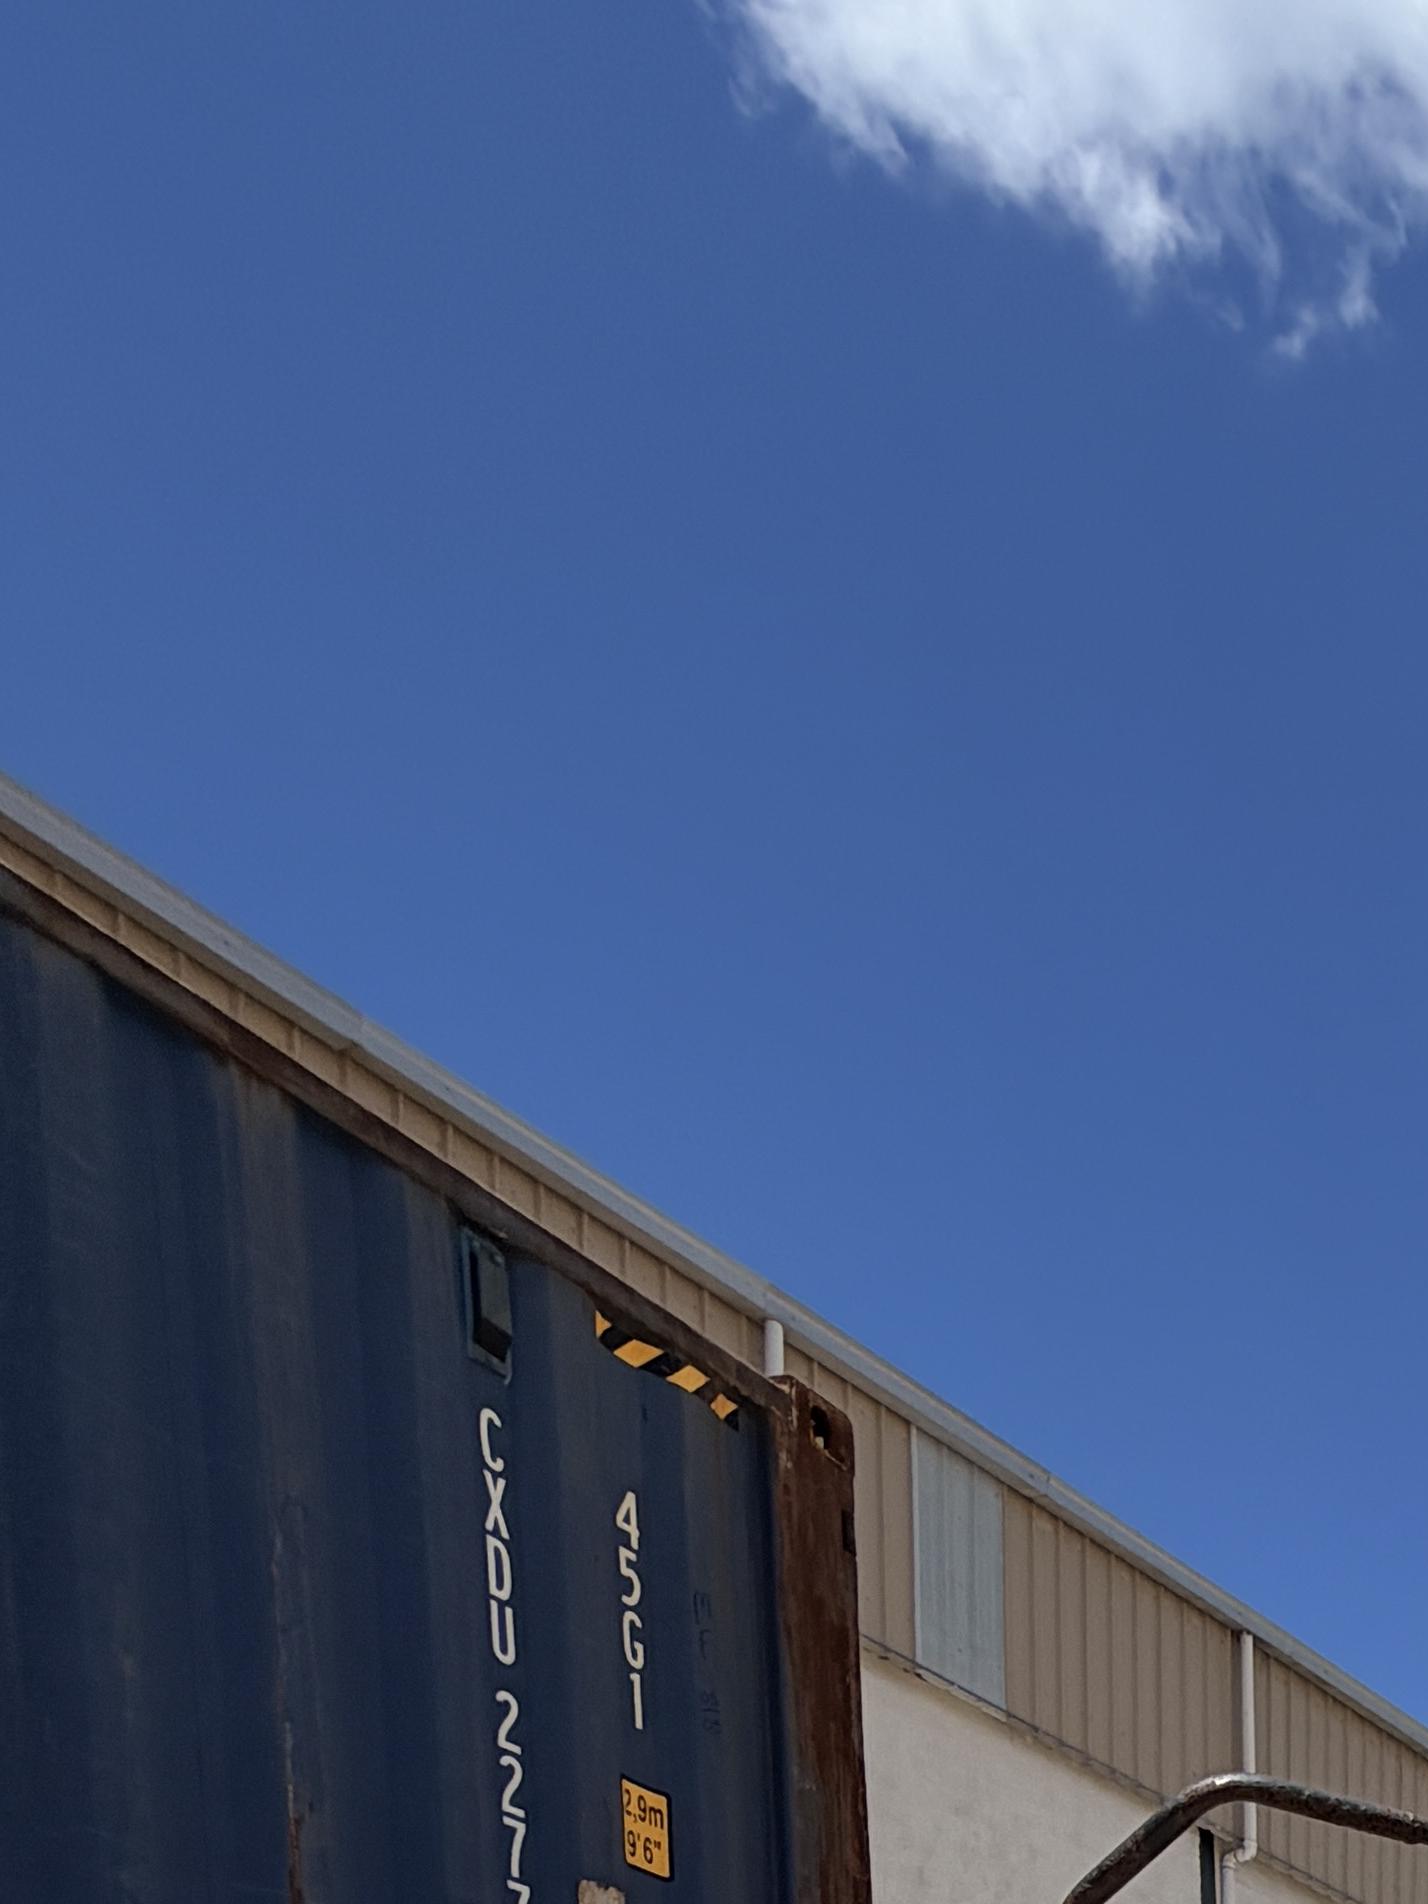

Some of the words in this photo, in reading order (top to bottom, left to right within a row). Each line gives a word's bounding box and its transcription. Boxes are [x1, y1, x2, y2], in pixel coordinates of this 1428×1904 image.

[479, 1407, 516, 1666] CXDU
[616, 1491, 645, 1730] 45G1
[624, 1788, 665, 1831] 2,9m
